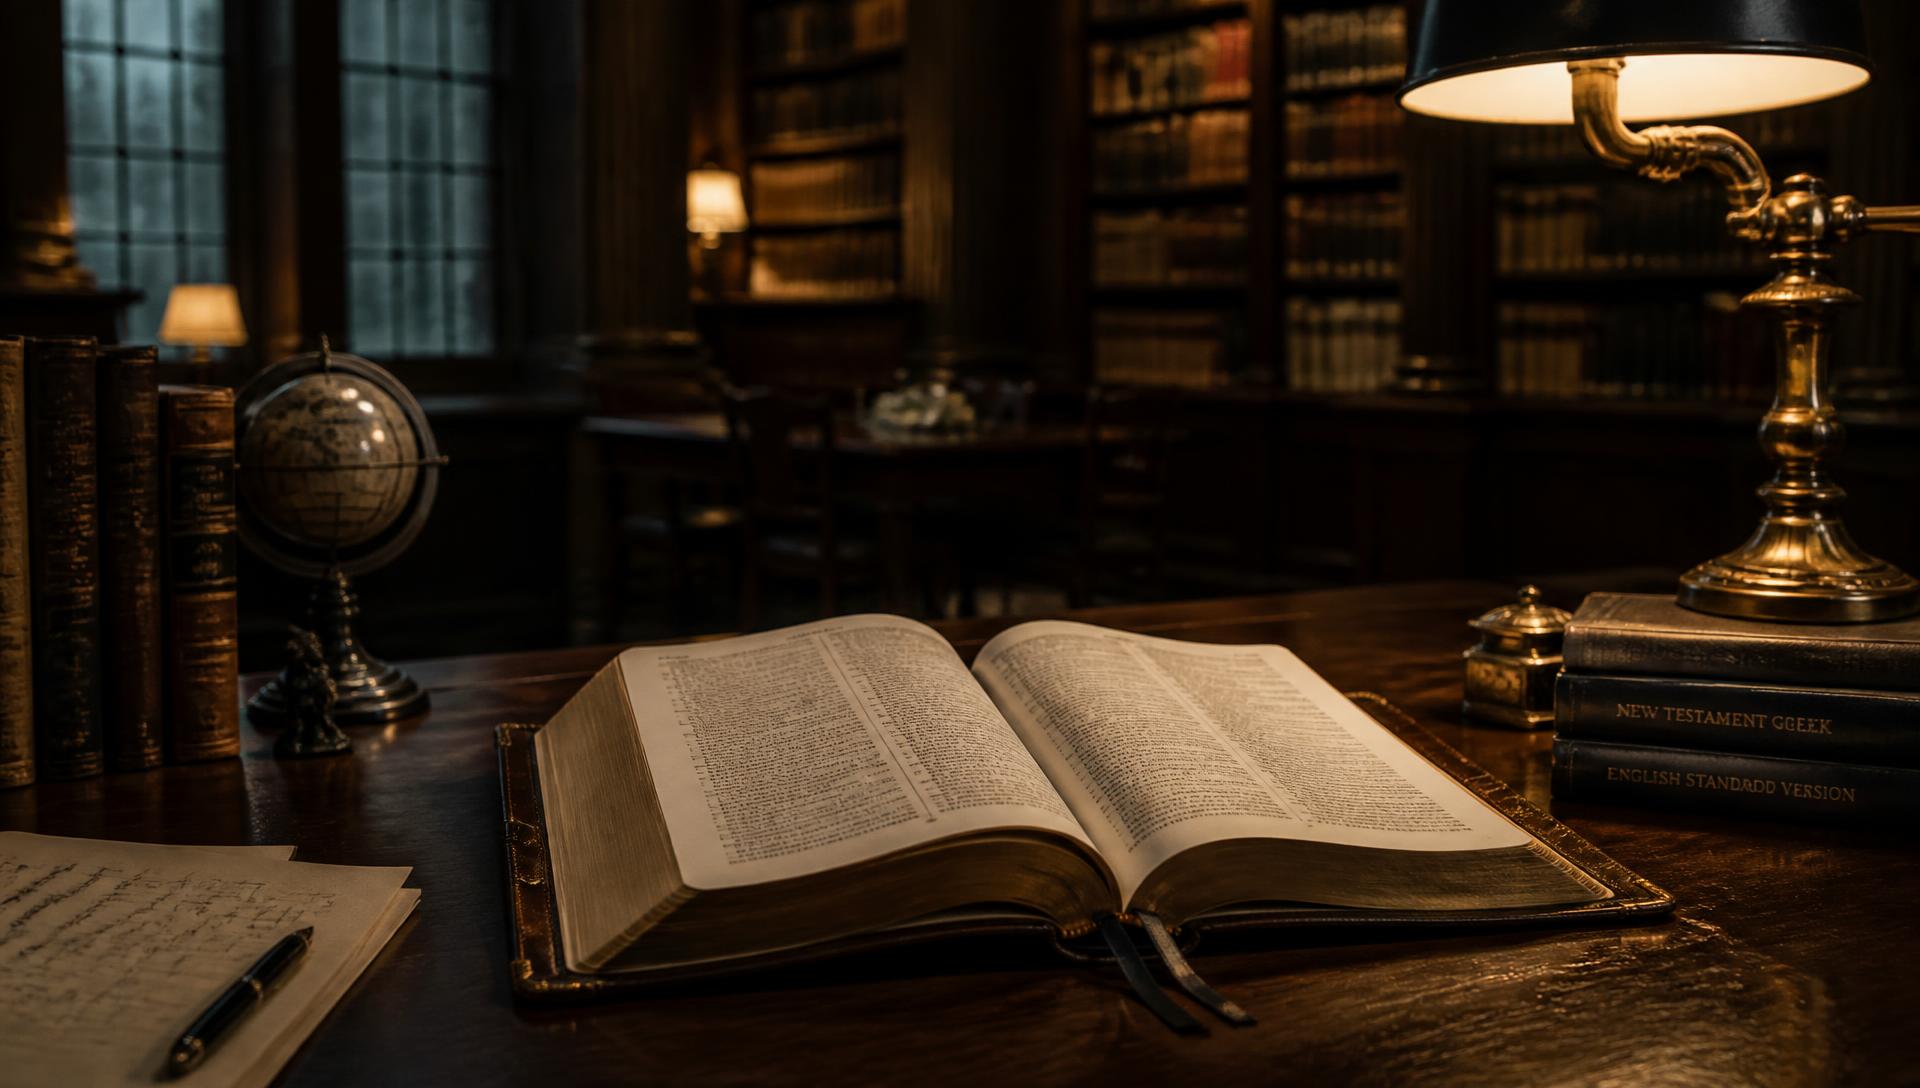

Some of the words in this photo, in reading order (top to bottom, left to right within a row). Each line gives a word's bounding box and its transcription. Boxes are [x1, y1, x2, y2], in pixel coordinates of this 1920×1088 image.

[1616, 703, 1658, 720] NEW
[1664, 707, 1768, 729] TESTAMENT
[1607, 767, 1681, 786] ENGLISH
[1780, 781, 1856, 803] VERSION
